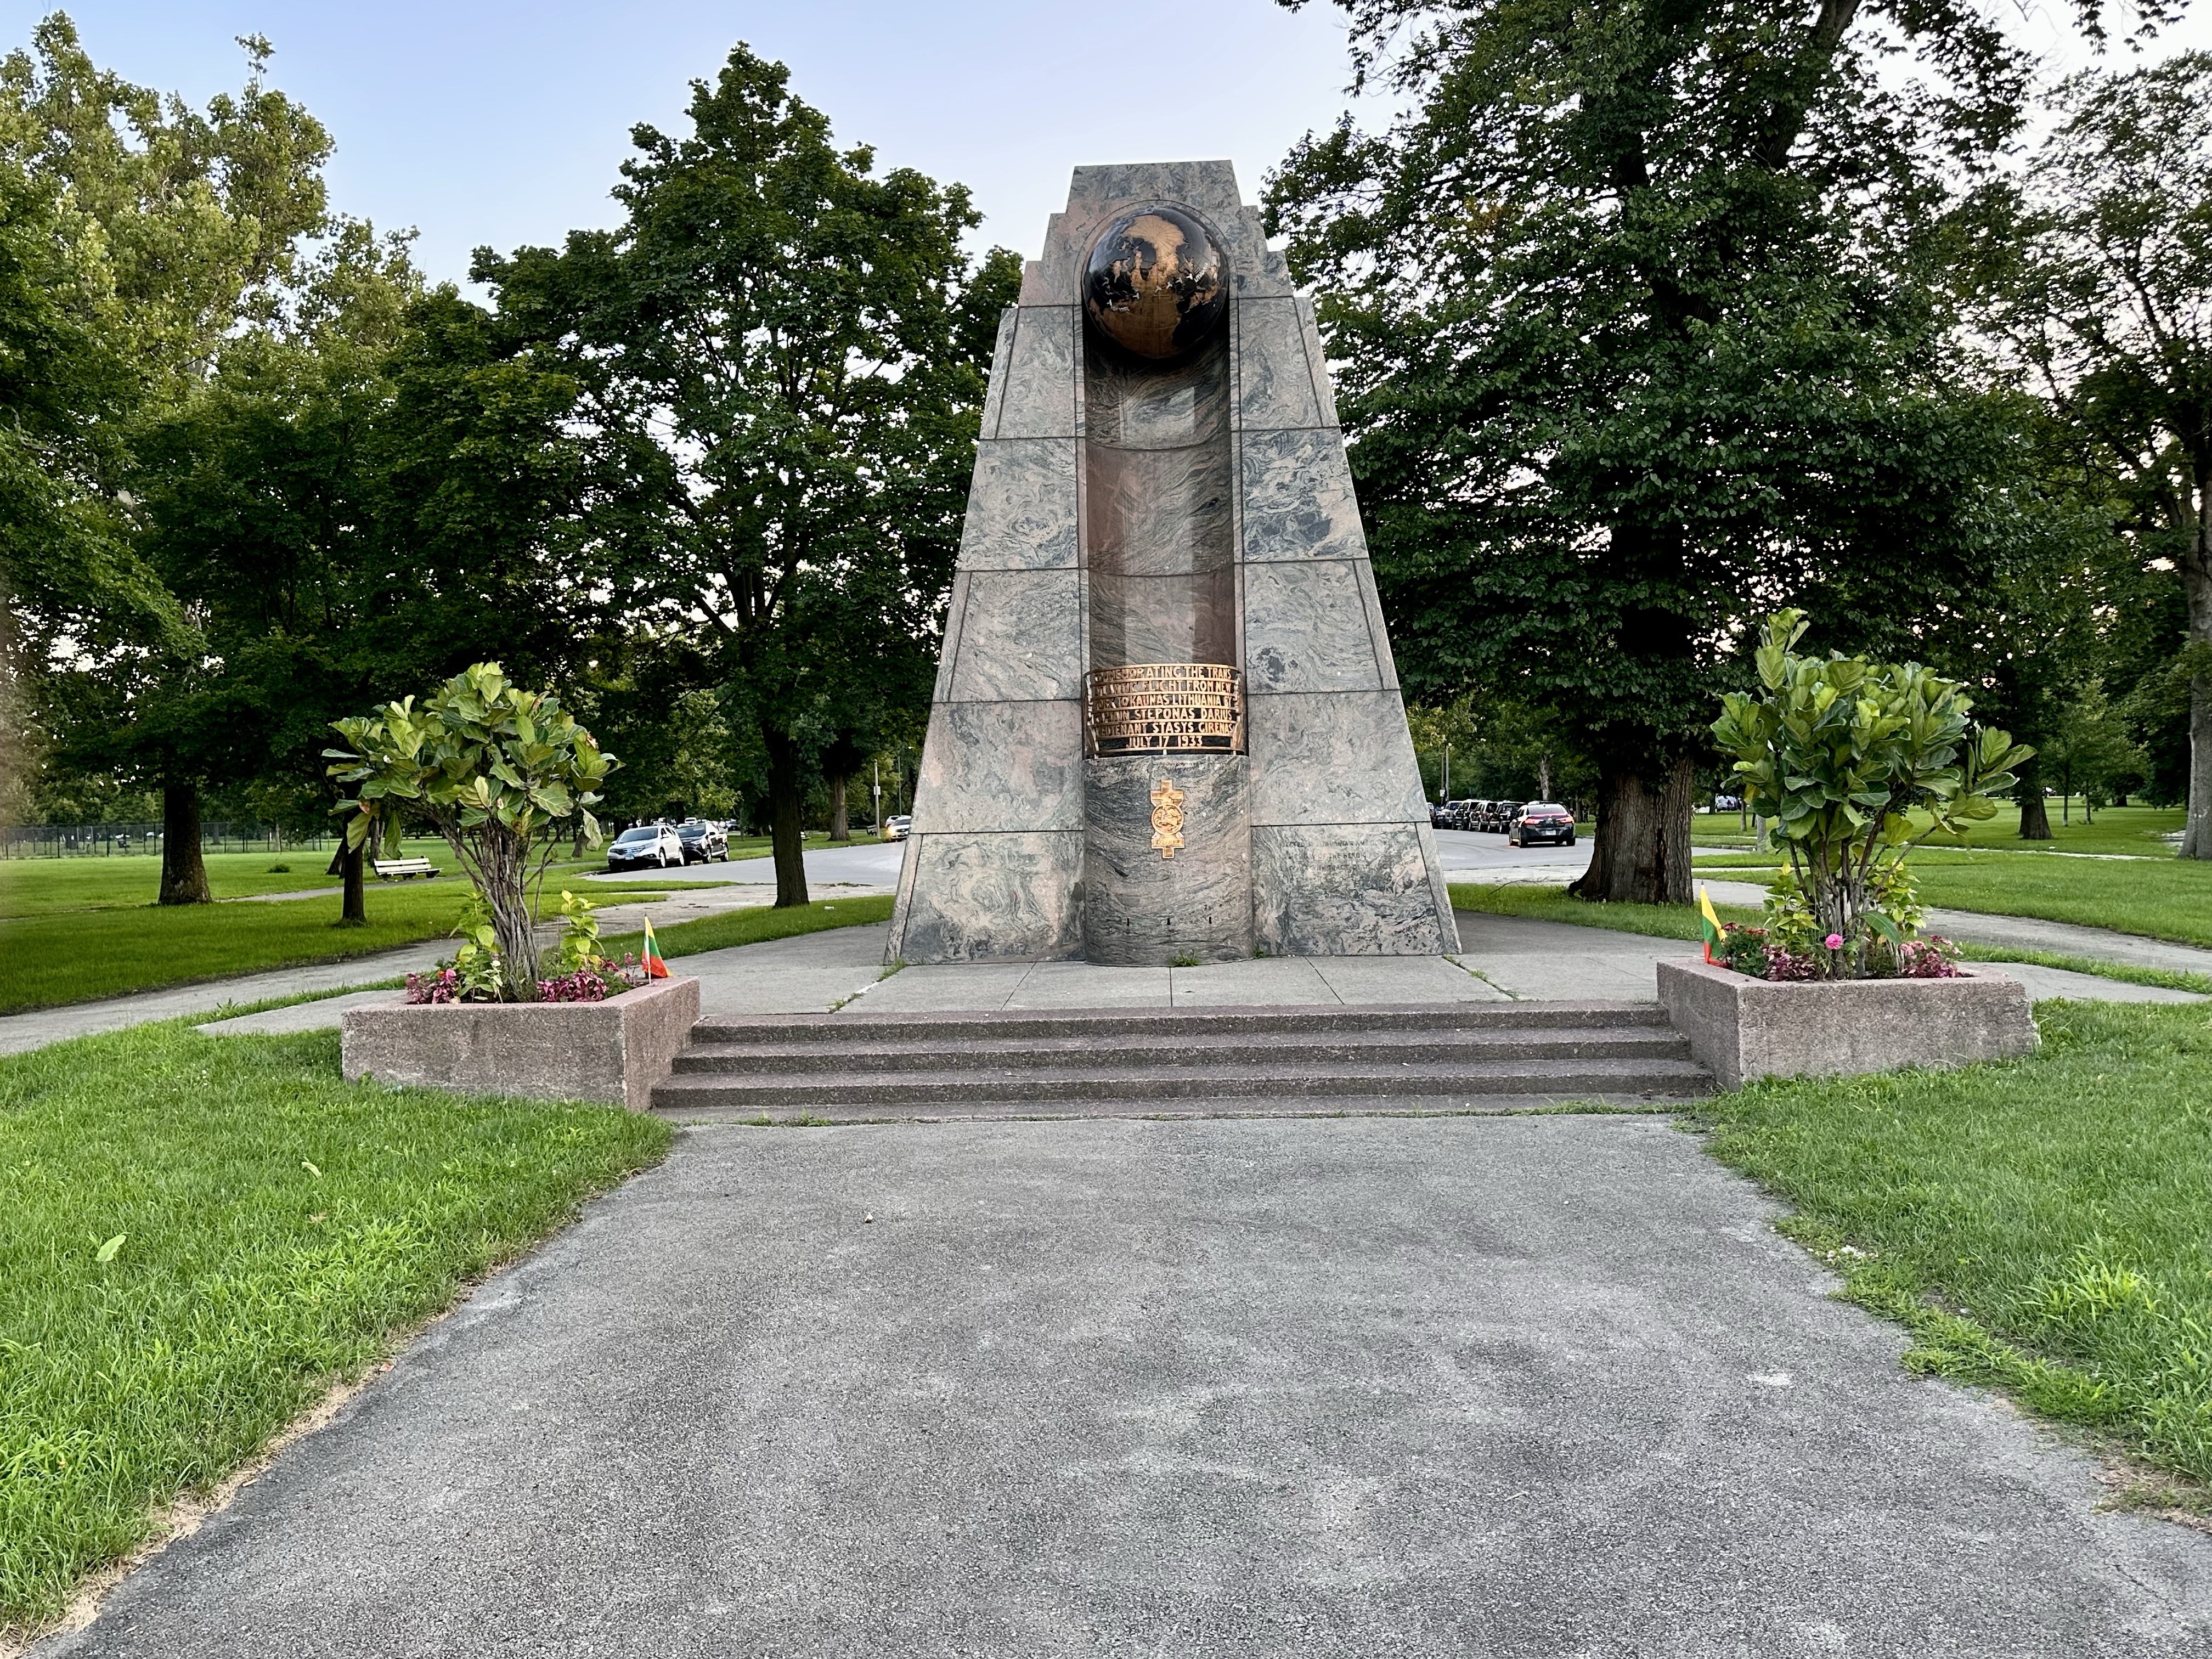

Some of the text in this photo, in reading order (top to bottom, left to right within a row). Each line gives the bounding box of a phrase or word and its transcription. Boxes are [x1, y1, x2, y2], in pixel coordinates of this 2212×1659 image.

[1184, 667, 1204, 678] THE
[1206, 667, 1231, 679] TRANS
[1142, 680, 1182, 691] FLIGHT
[1186, 680, 1214, 691] FROM
[1216, 681, 1231, 693] NEW
[1118, 697, 1128, 706] TO
[1130, 694, 1170, 706] KAUNAS
[1172, 694, 1221, 706] LITHUANIA
[1224, 696, 1232, 707] BY
[1135, 708, 1195, 719] STEPONAS
[1200, 708, 1232, 720] DARIUS
[1152, 721, 1194, 733] STASYS
[1126, 736, 1203, 747] JULY 17 1933
